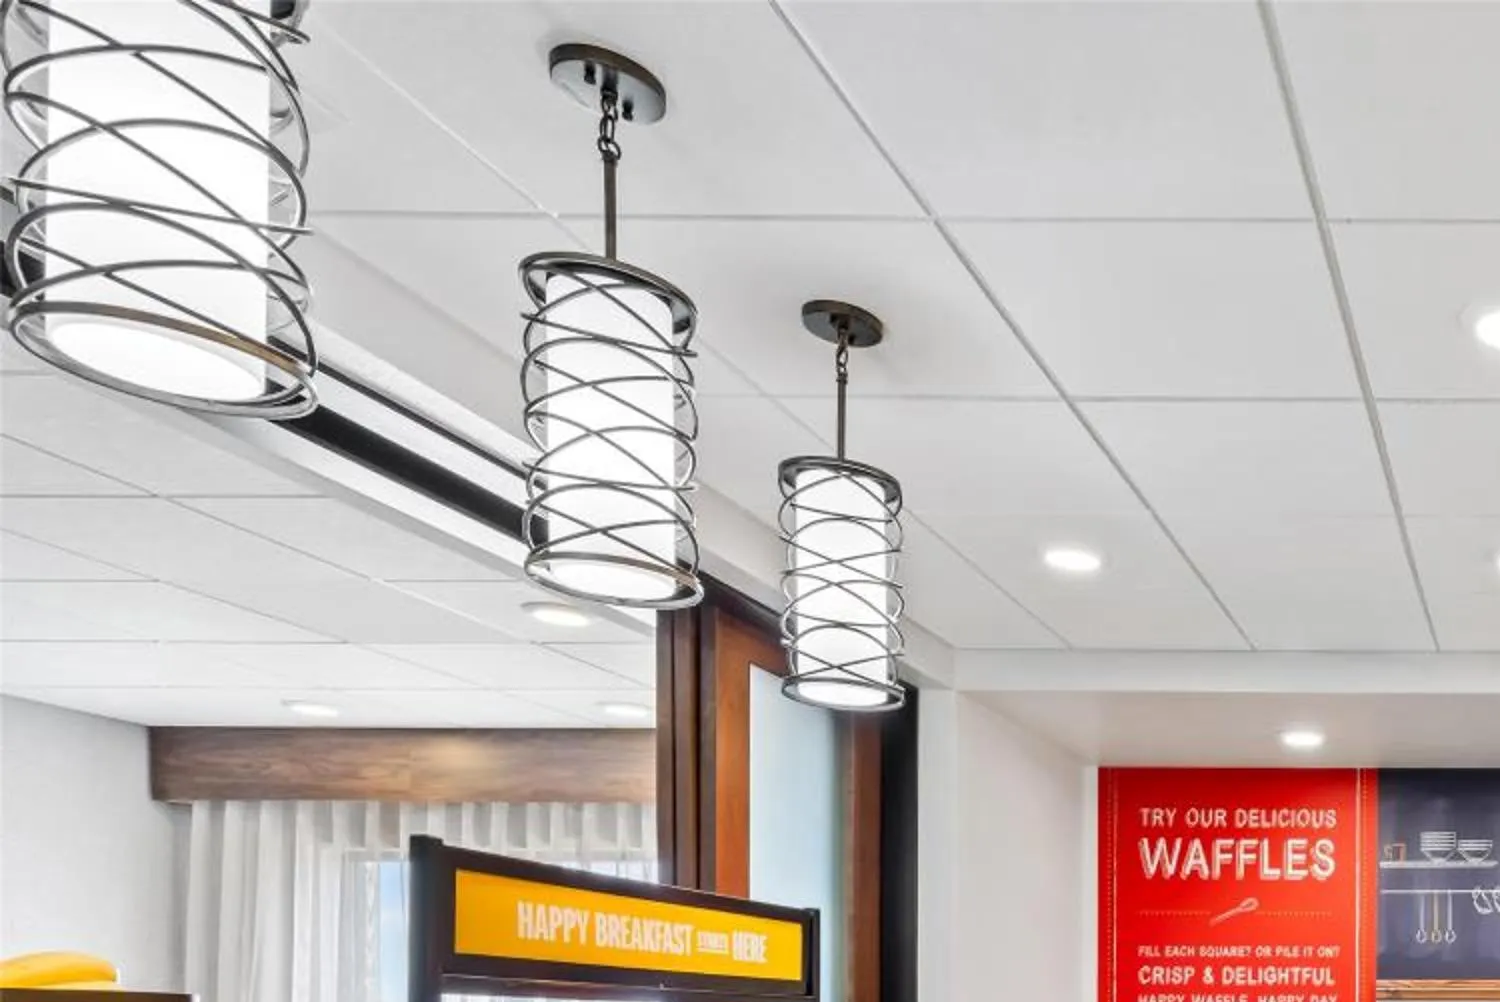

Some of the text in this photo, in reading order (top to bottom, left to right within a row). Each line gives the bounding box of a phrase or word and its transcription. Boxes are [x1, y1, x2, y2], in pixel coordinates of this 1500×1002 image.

[1138, 807, 1337, 828] TRY OUR DELICIOUS
[1138, 837, 1336, 881] WAFFLES
[517, 900, 590, 944] HAPPY
[594, 914, 693, 957] BREAKFAST
[732, 929, 768, 964] HERE
[1137, 945, 1161, 957] FILL
[1165, 945, 1195, 957] EACH
[1255, 945, 1272, 957] OR
[1275, 945, 1299, 957] PILE
[1302, 945, 1313, 957] IT
[1137, 965, 1336, 987] CRISP & DELIGHTFUL
